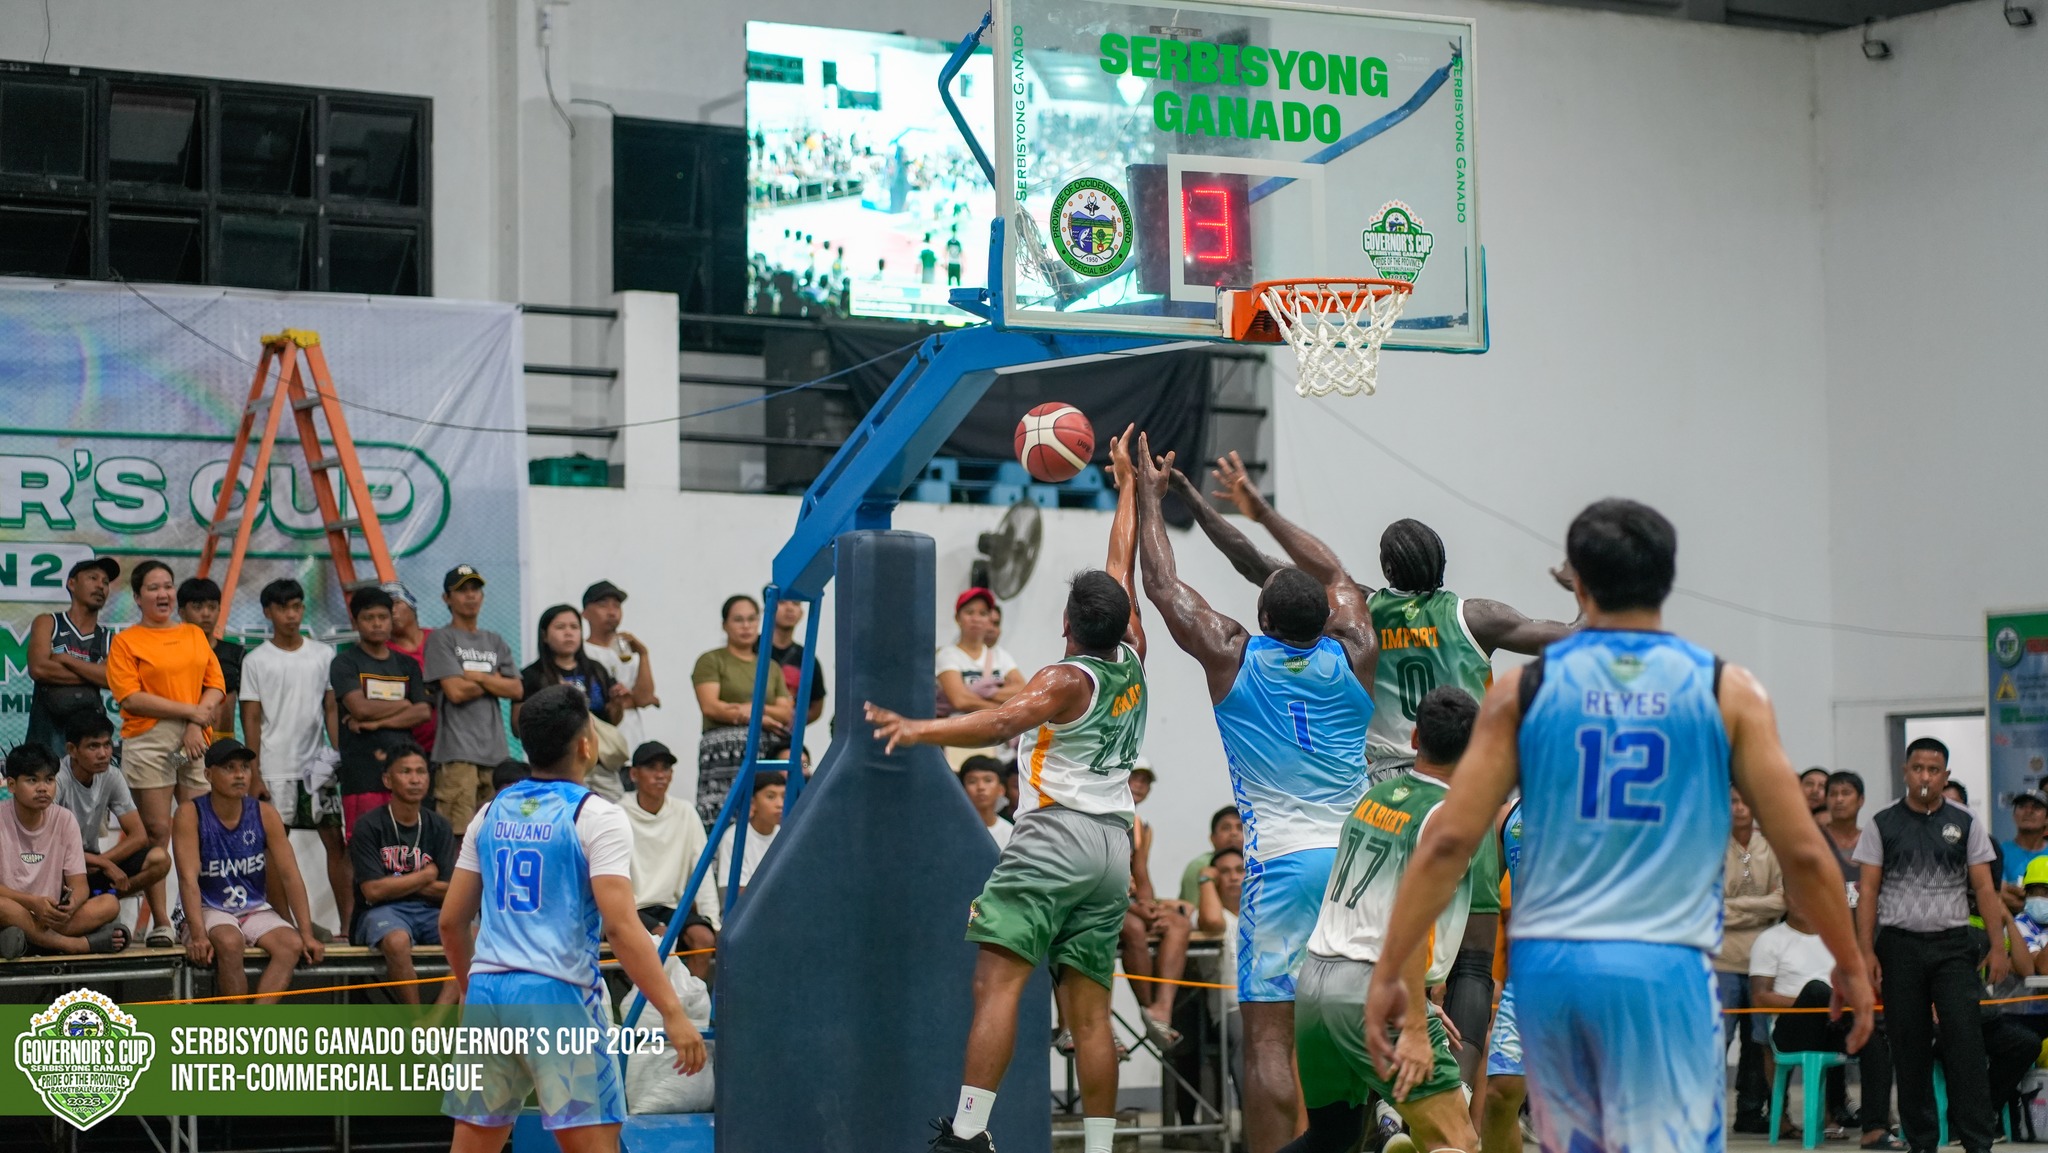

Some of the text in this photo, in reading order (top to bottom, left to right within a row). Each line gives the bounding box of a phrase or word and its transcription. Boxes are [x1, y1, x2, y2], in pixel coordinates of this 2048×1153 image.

[1100, 32, 1389, 98] SERBISYONG
[1012, 25, 1027, 201] SERBISYONG GANADO
[1153, 90, 1341, 144] GANADO
[1453, 56, 1467, 224] SERBISYONG GANADO
[1051, 179, 1132, 243] PROVINCE OF OCCIDENTAL MINDORO
[1069, 259, 1117, 274] OFFICIAL SEAL
[1364, 232, 1432, 255] GOVERNOR'S CUP
[31, 553, 63, 587] 2
[1381, 626, 1439, 650] IMPORT
[1396, 655, 1436, 722] 0
[1585, 689, 1667, 717] REYES
[1287, 700, 1317, 753] 1
[1577, 726, 1668, 825] 12
[222, 885, 248, 909] 29
[496, 847, 543, 914] 19
[1330, 826, 1393, 910] 17
